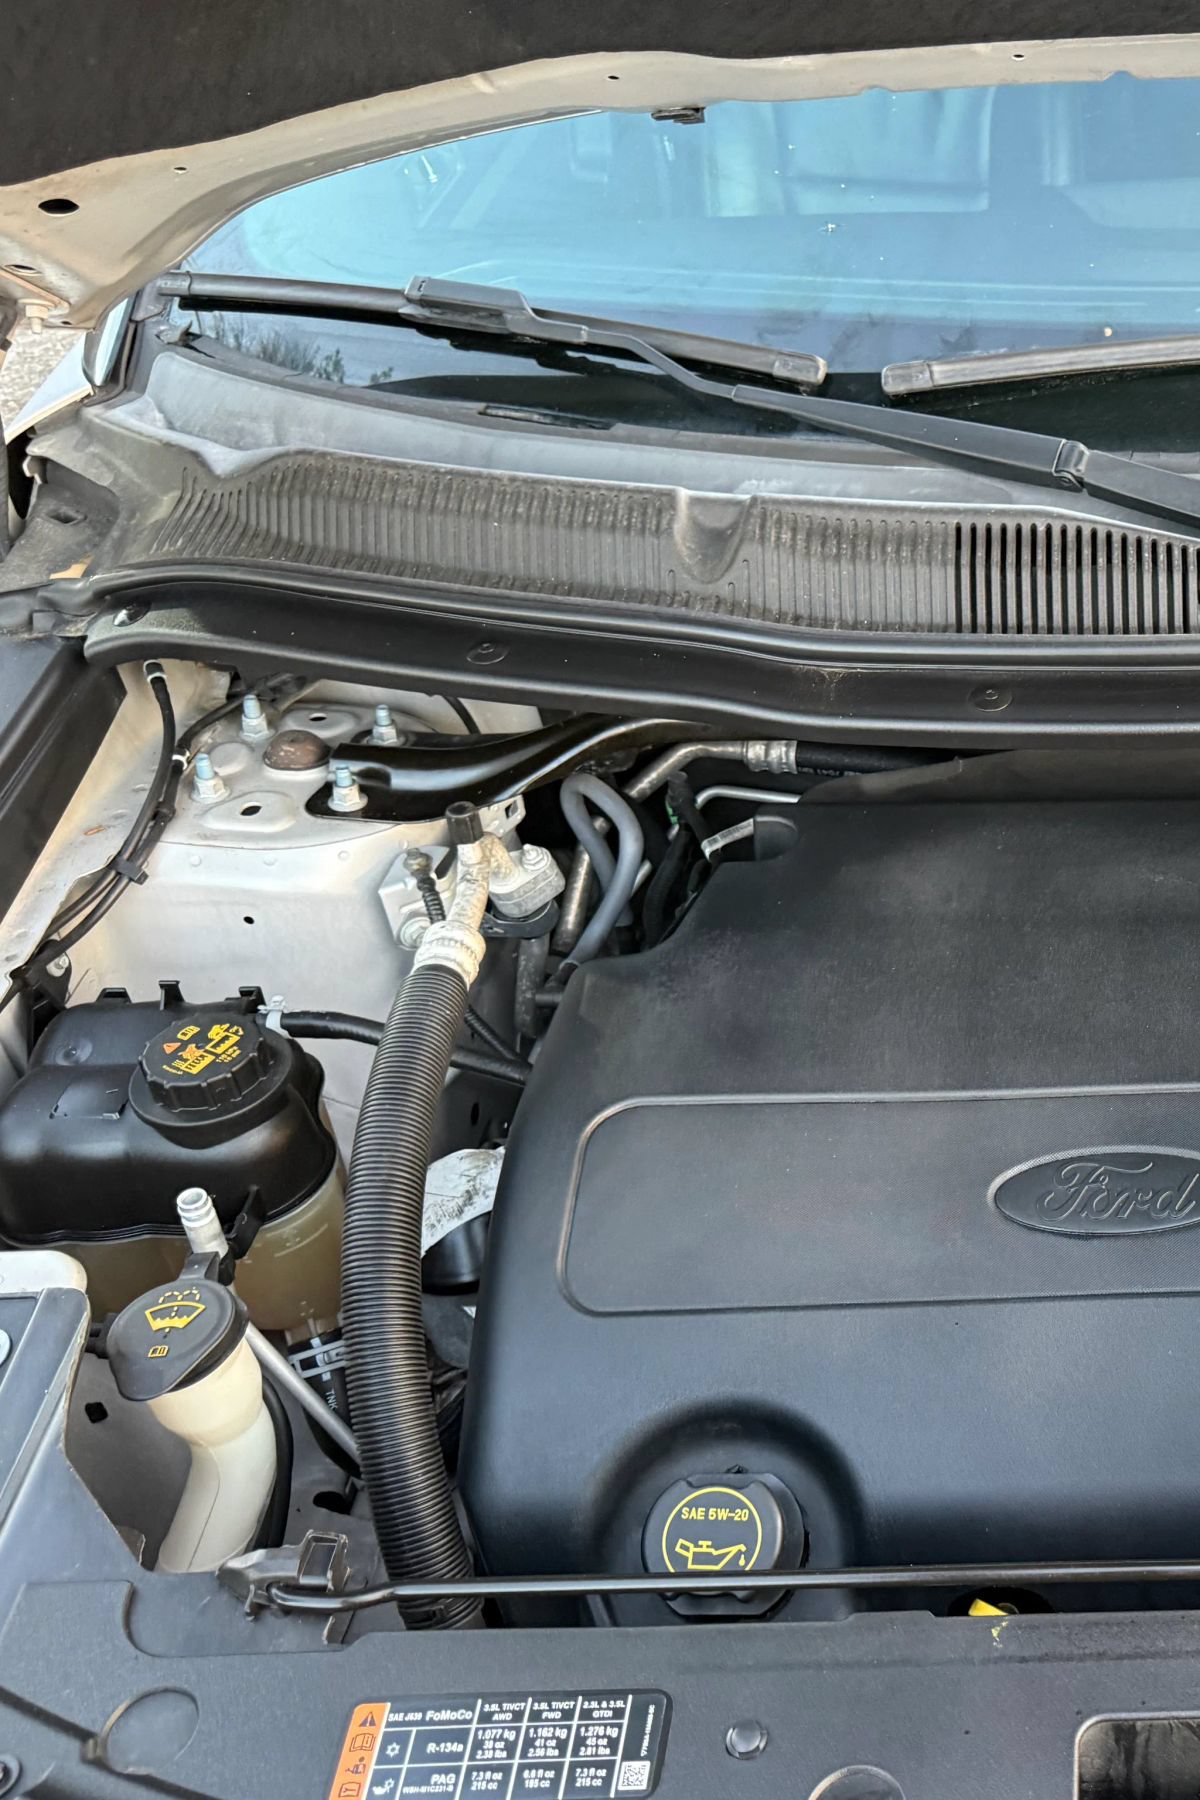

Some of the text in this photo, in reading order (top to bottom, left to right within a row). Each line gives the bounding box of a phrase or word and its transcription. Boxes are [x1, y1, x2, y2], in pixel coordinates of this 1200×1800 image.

[1037, 1161, 1200, 1222] Ford
[681, 1507, 749, 1521] SAE 5W-20
[484, 1703, 500, 1712] 3.5L
[532, 1702, 549, 1710] 3.5L
[583, 1701, 599, 1709] 2.3L
[609, 1700, 625, 1708] 3.5L
[388, 1709, 473, 1722] SAE J639 FoMoCo
[542, 1711, 562, 1719] FWD
[478, 1728, 516, 1741] 1.077 kg
[529, 1727, 567, 1739] 1.162 kg
[580, 1725, 618, 1738] 1.276 kg
[534, 1739, 544, 1747] 41
[586, 1738, 596, 1746] 45
[426, 1742, 464, 1754] R-134a
[471, 1771, 484, 1780] 7.3
[576, 1768, 588, 1777] 7.3
[430, 1773, 456, 1785] PAG
[575, 1778, 590, 1787] 215
[471, 1782, 498, 1790] 215 cc
[540, 1780, 550, 1788] cc
